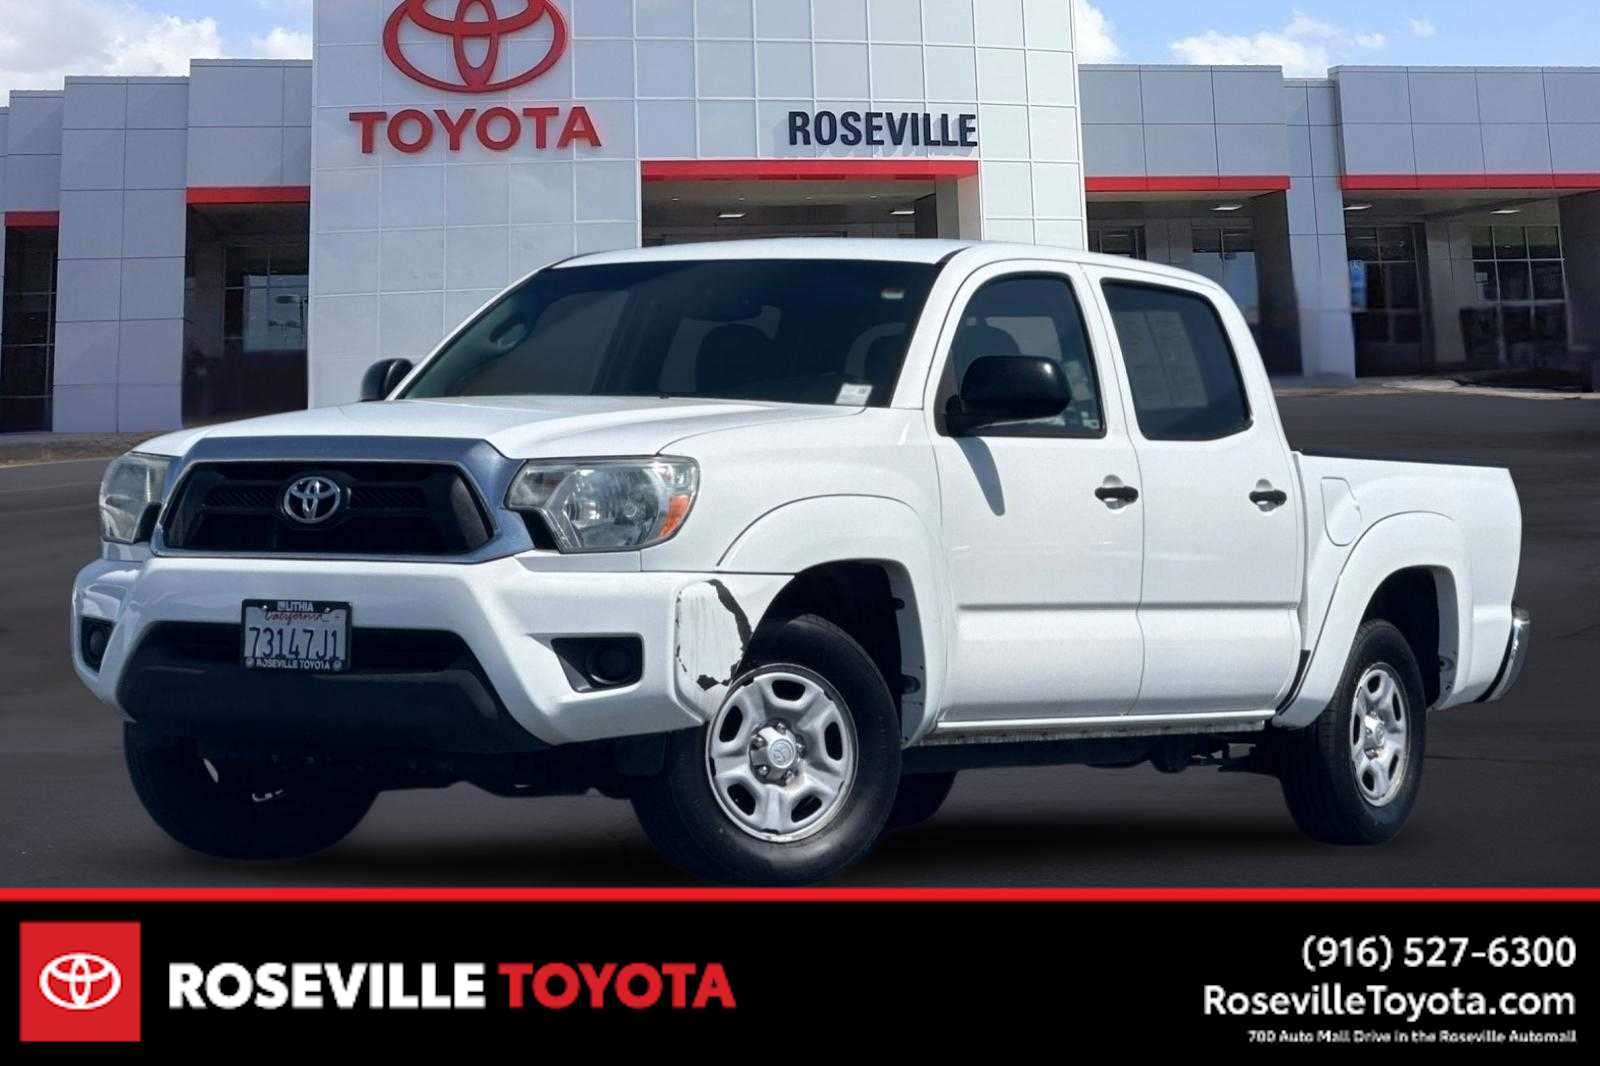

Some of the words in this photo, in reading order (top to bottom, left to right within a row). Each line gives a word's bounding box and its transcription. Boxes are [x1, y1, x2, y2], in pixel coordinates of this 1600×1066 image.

[349, 106, 603, 154] TOYOTA
[788, 110, 979, 147] ROSEVILLE
[248, 626, 338, 660] 73147J1
[256, 659, 299, 669] ROSEVILLE
[300, 660, 330, 670] TOYOTA
